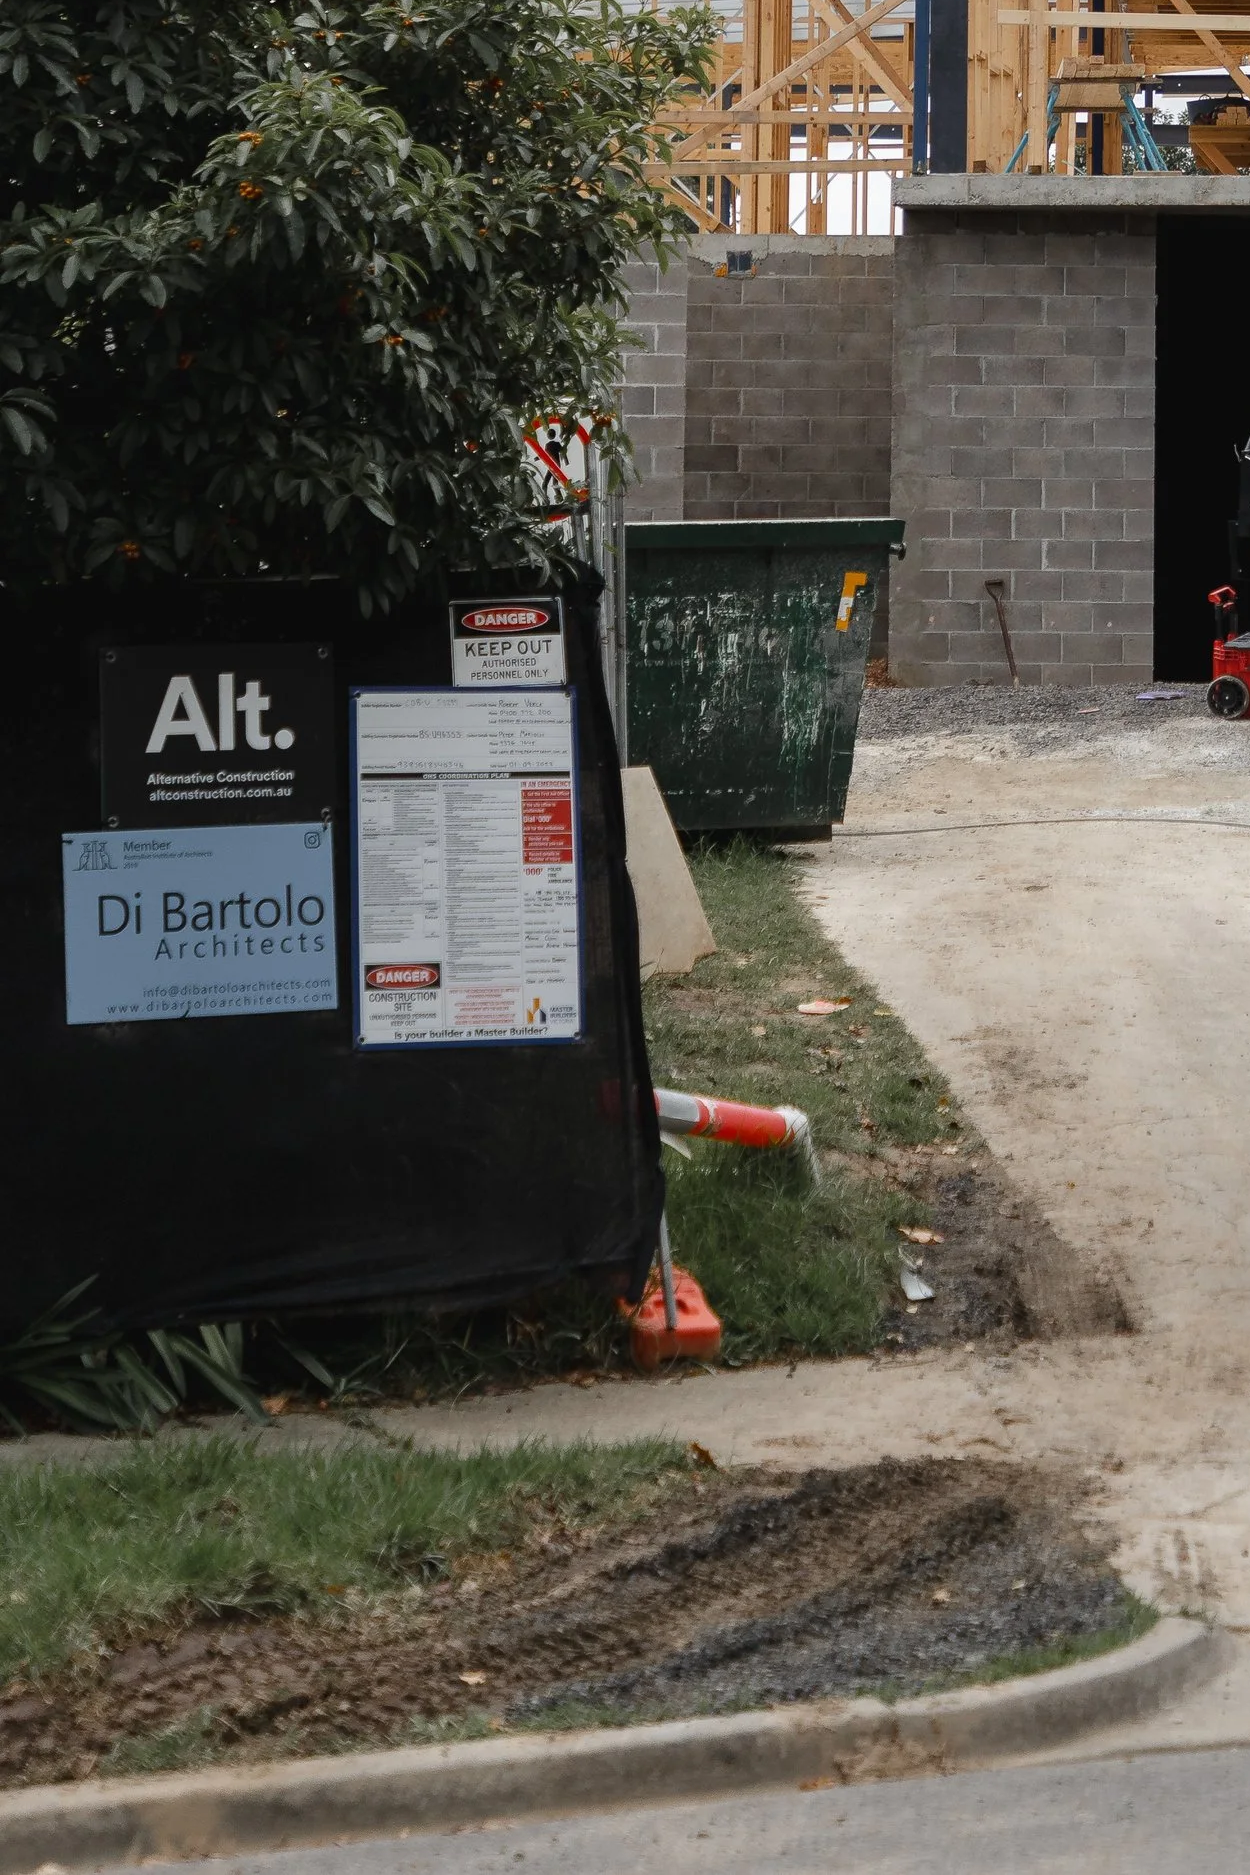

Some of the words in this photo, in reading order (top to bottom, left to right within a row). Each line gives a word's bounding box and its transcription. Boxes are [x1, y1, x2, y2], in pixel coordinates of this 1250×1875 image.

[474, 612, 537, 626] DANGER
[464, 641, 512, 658] KEEP
[517, 639, 552, 655] OUT
[481, 657, 537, 668] AUTHORISED
[470, 671, 524, 681] PERSONNEL
[525, 669, 549, 678] ONLY
[145, 672, 295, 754] Alt.
[146, 773, 215, 785] Alternative
[216, 770, 295, 783] Construction
[149, 786, 293, 802] altconstruction.com.au
[123, 840, 172, 853] Member
[97, 891, 142, 937] Di
[162, 882, 325, 934] Bartolo
[154, 933, 326, 961] Architects
[375, 969, 430, 984] DANGER
[142, 978, 331, 999] info@dibartoloarchitects.com
[106, 992, 333, 1015] www.dibartoloarchitects.com
[368, 991, 437, 1003] CONSTRUCTION
[394, 1002, 412, 1012] SITE
[394, 1031, 402, 1039] Is
[404, 1032, 426, 1042] your
[429, 1031, 463, 1039] builder
[474, 1029, 508, 1038] Master
[509, 1027, 549, 1036] Builder?
